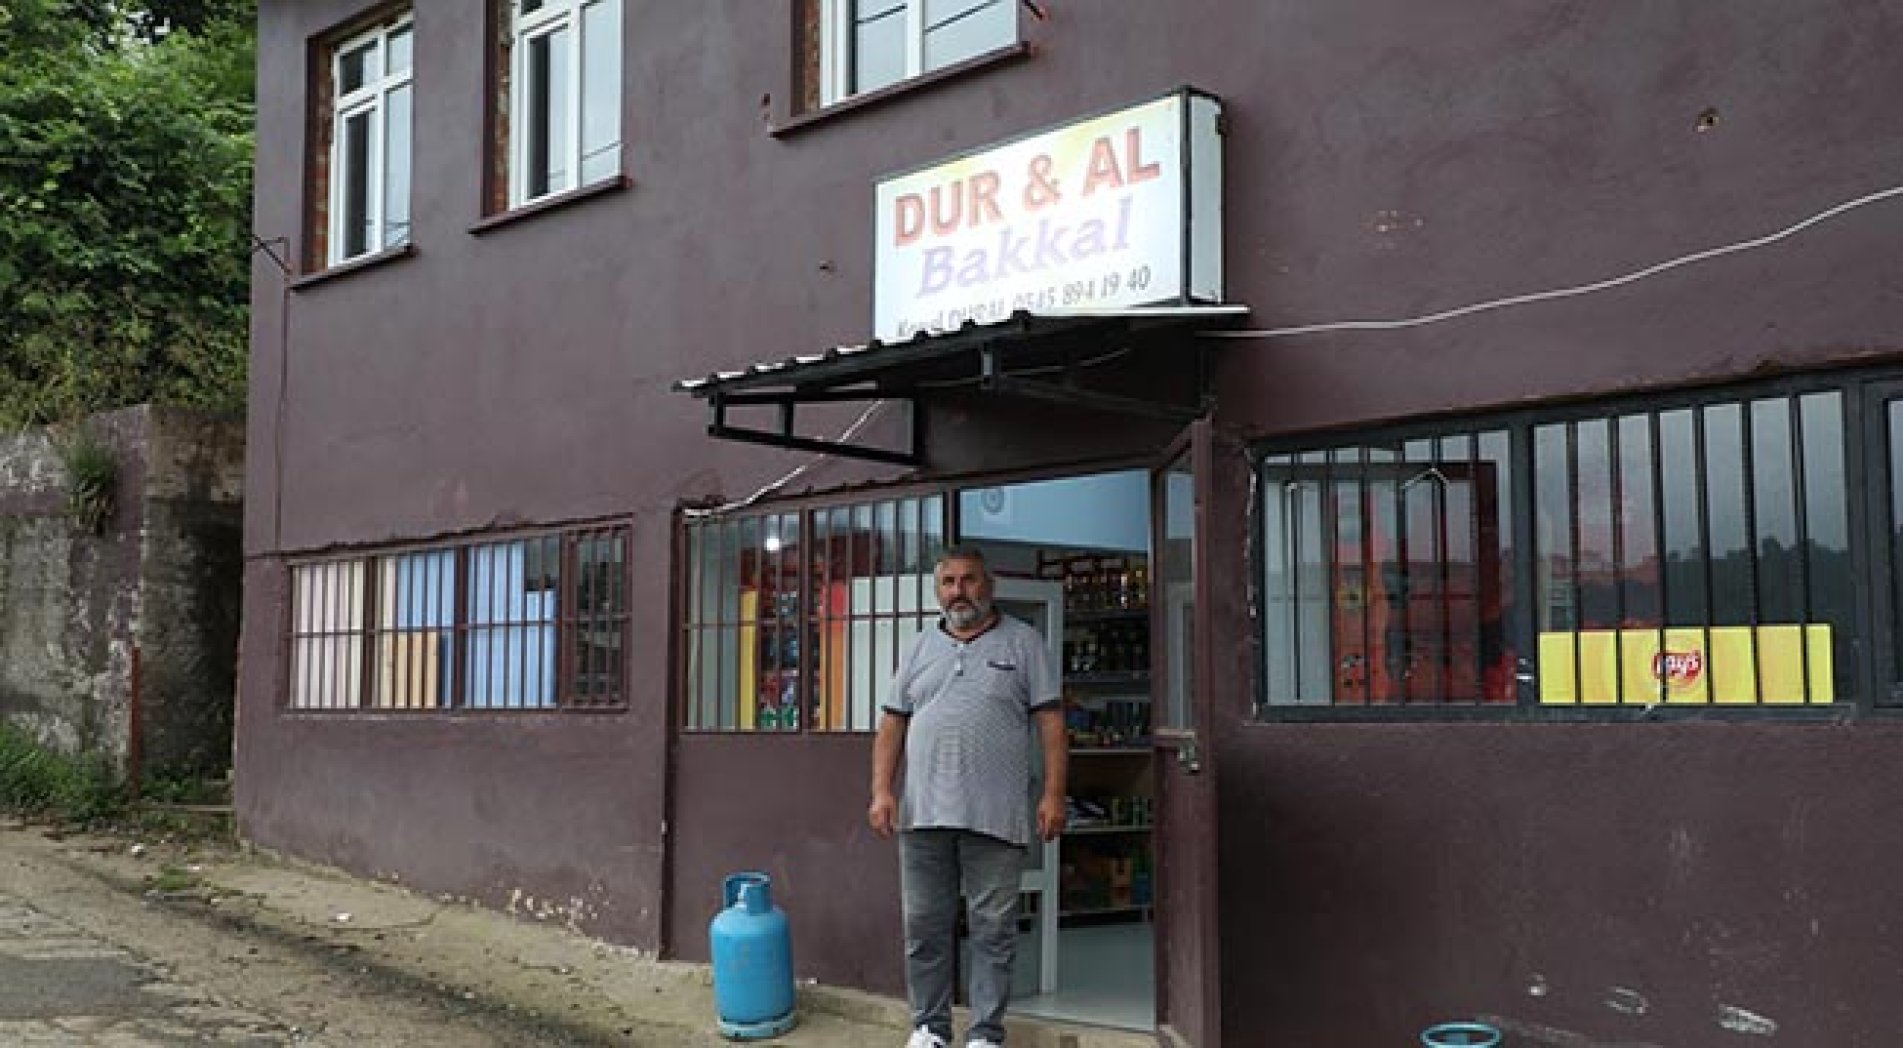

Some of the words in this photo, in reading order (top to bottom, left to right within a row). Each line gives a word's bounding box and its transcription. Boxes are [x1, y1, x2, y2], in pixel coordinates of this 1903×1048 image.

[894, 170, 1002, 248] DUR
[1022, 154, 1062, 211] &
[1083, 126, 1161, 197] AL
[915, 195, 1133, 298] Bakkal
[1062, 280, 1096, 305] 894
[1101, 272, 1121, 297] 19
[1127, 264, 1152, 290] 40
